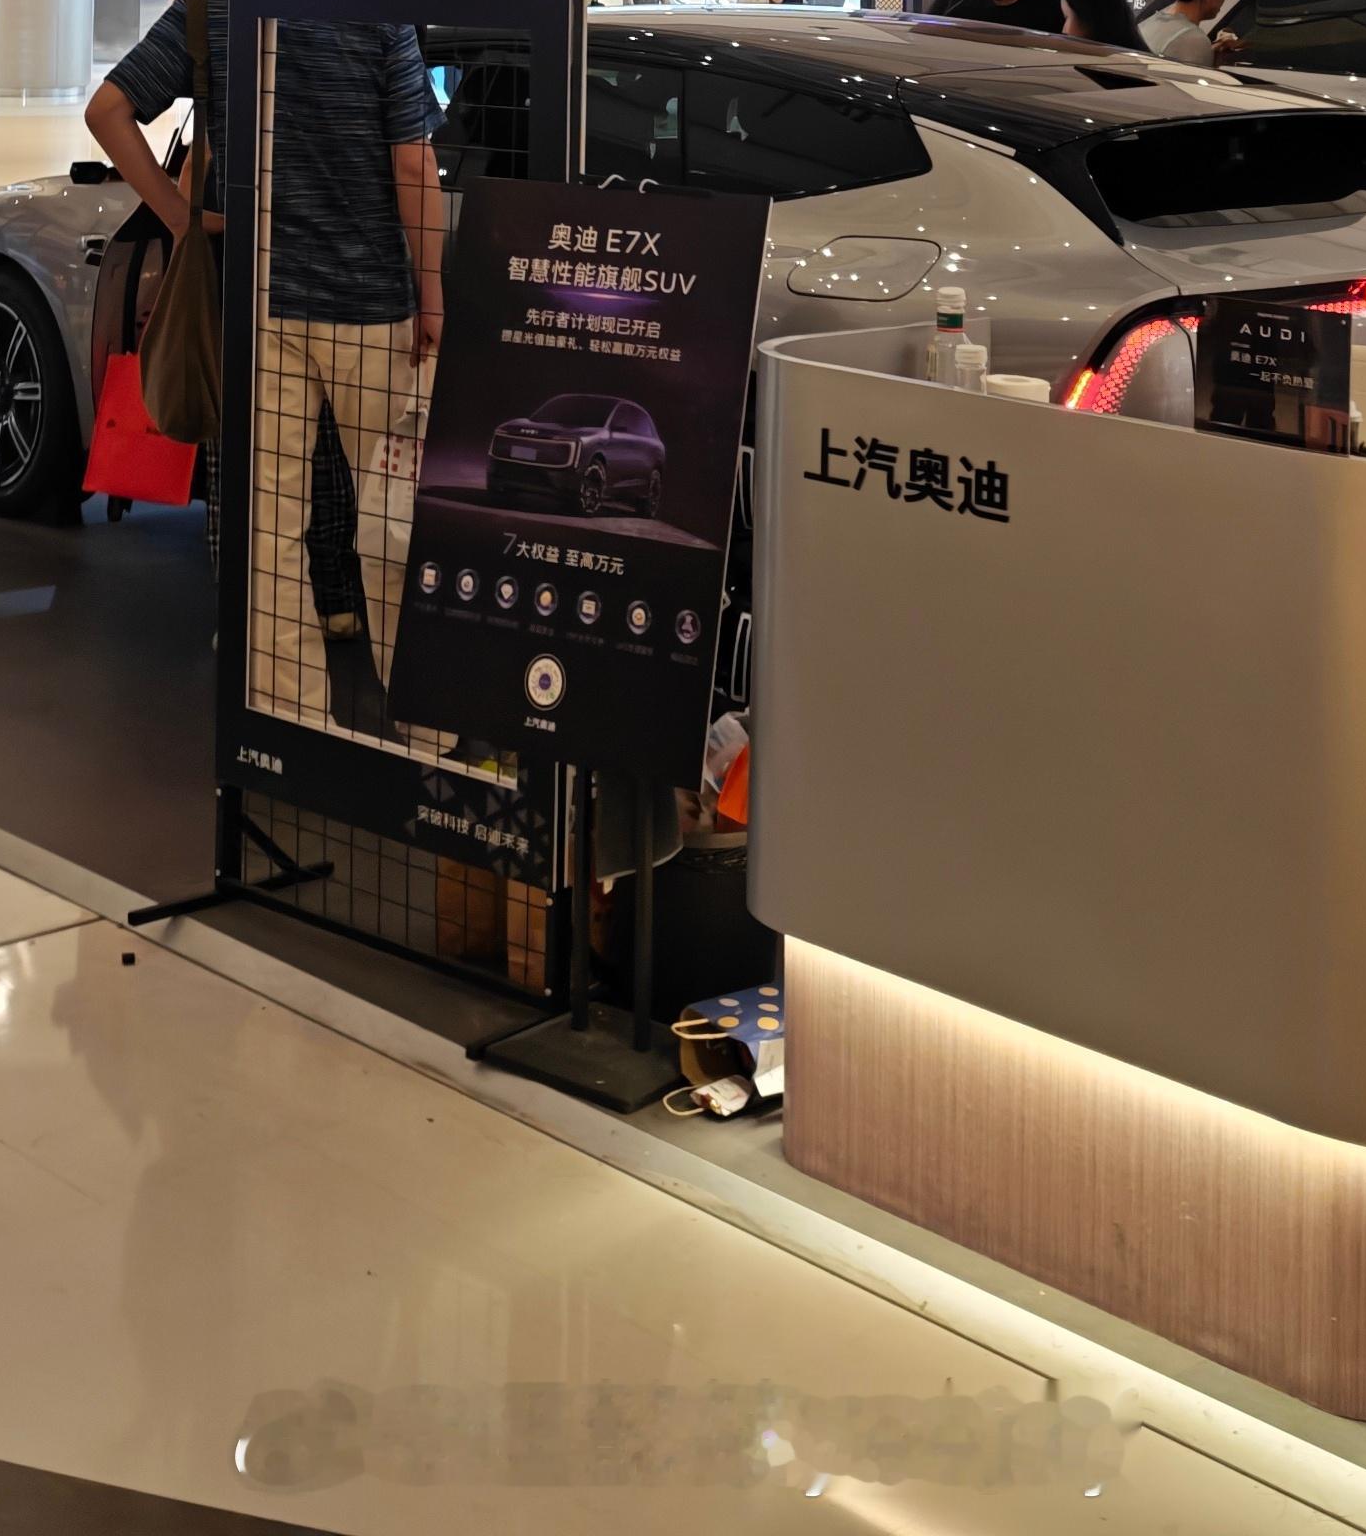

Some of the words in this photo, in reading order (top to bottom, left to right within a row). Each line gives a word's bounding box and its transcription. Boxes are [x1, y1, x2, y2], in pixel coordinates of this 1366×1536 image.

[547, 223, 598, 254] 奥迪
[605, 228, 661, 257] E7X
[507, 256, 697, 296] 智慧性能旗舰SUV
[525, 308, 662, 339] 先行者计划现已开启
[1239, 323, 1306, 344] AUDI
[1255, 354, 1278, 367] E7X
[803, 427, 1010, 524] 上汽奥迪
[502, 531, 560, 564] 7大权益
[565, 548, 625, 576] 至高万元
[417, 804, 469, 835] 突破科技
